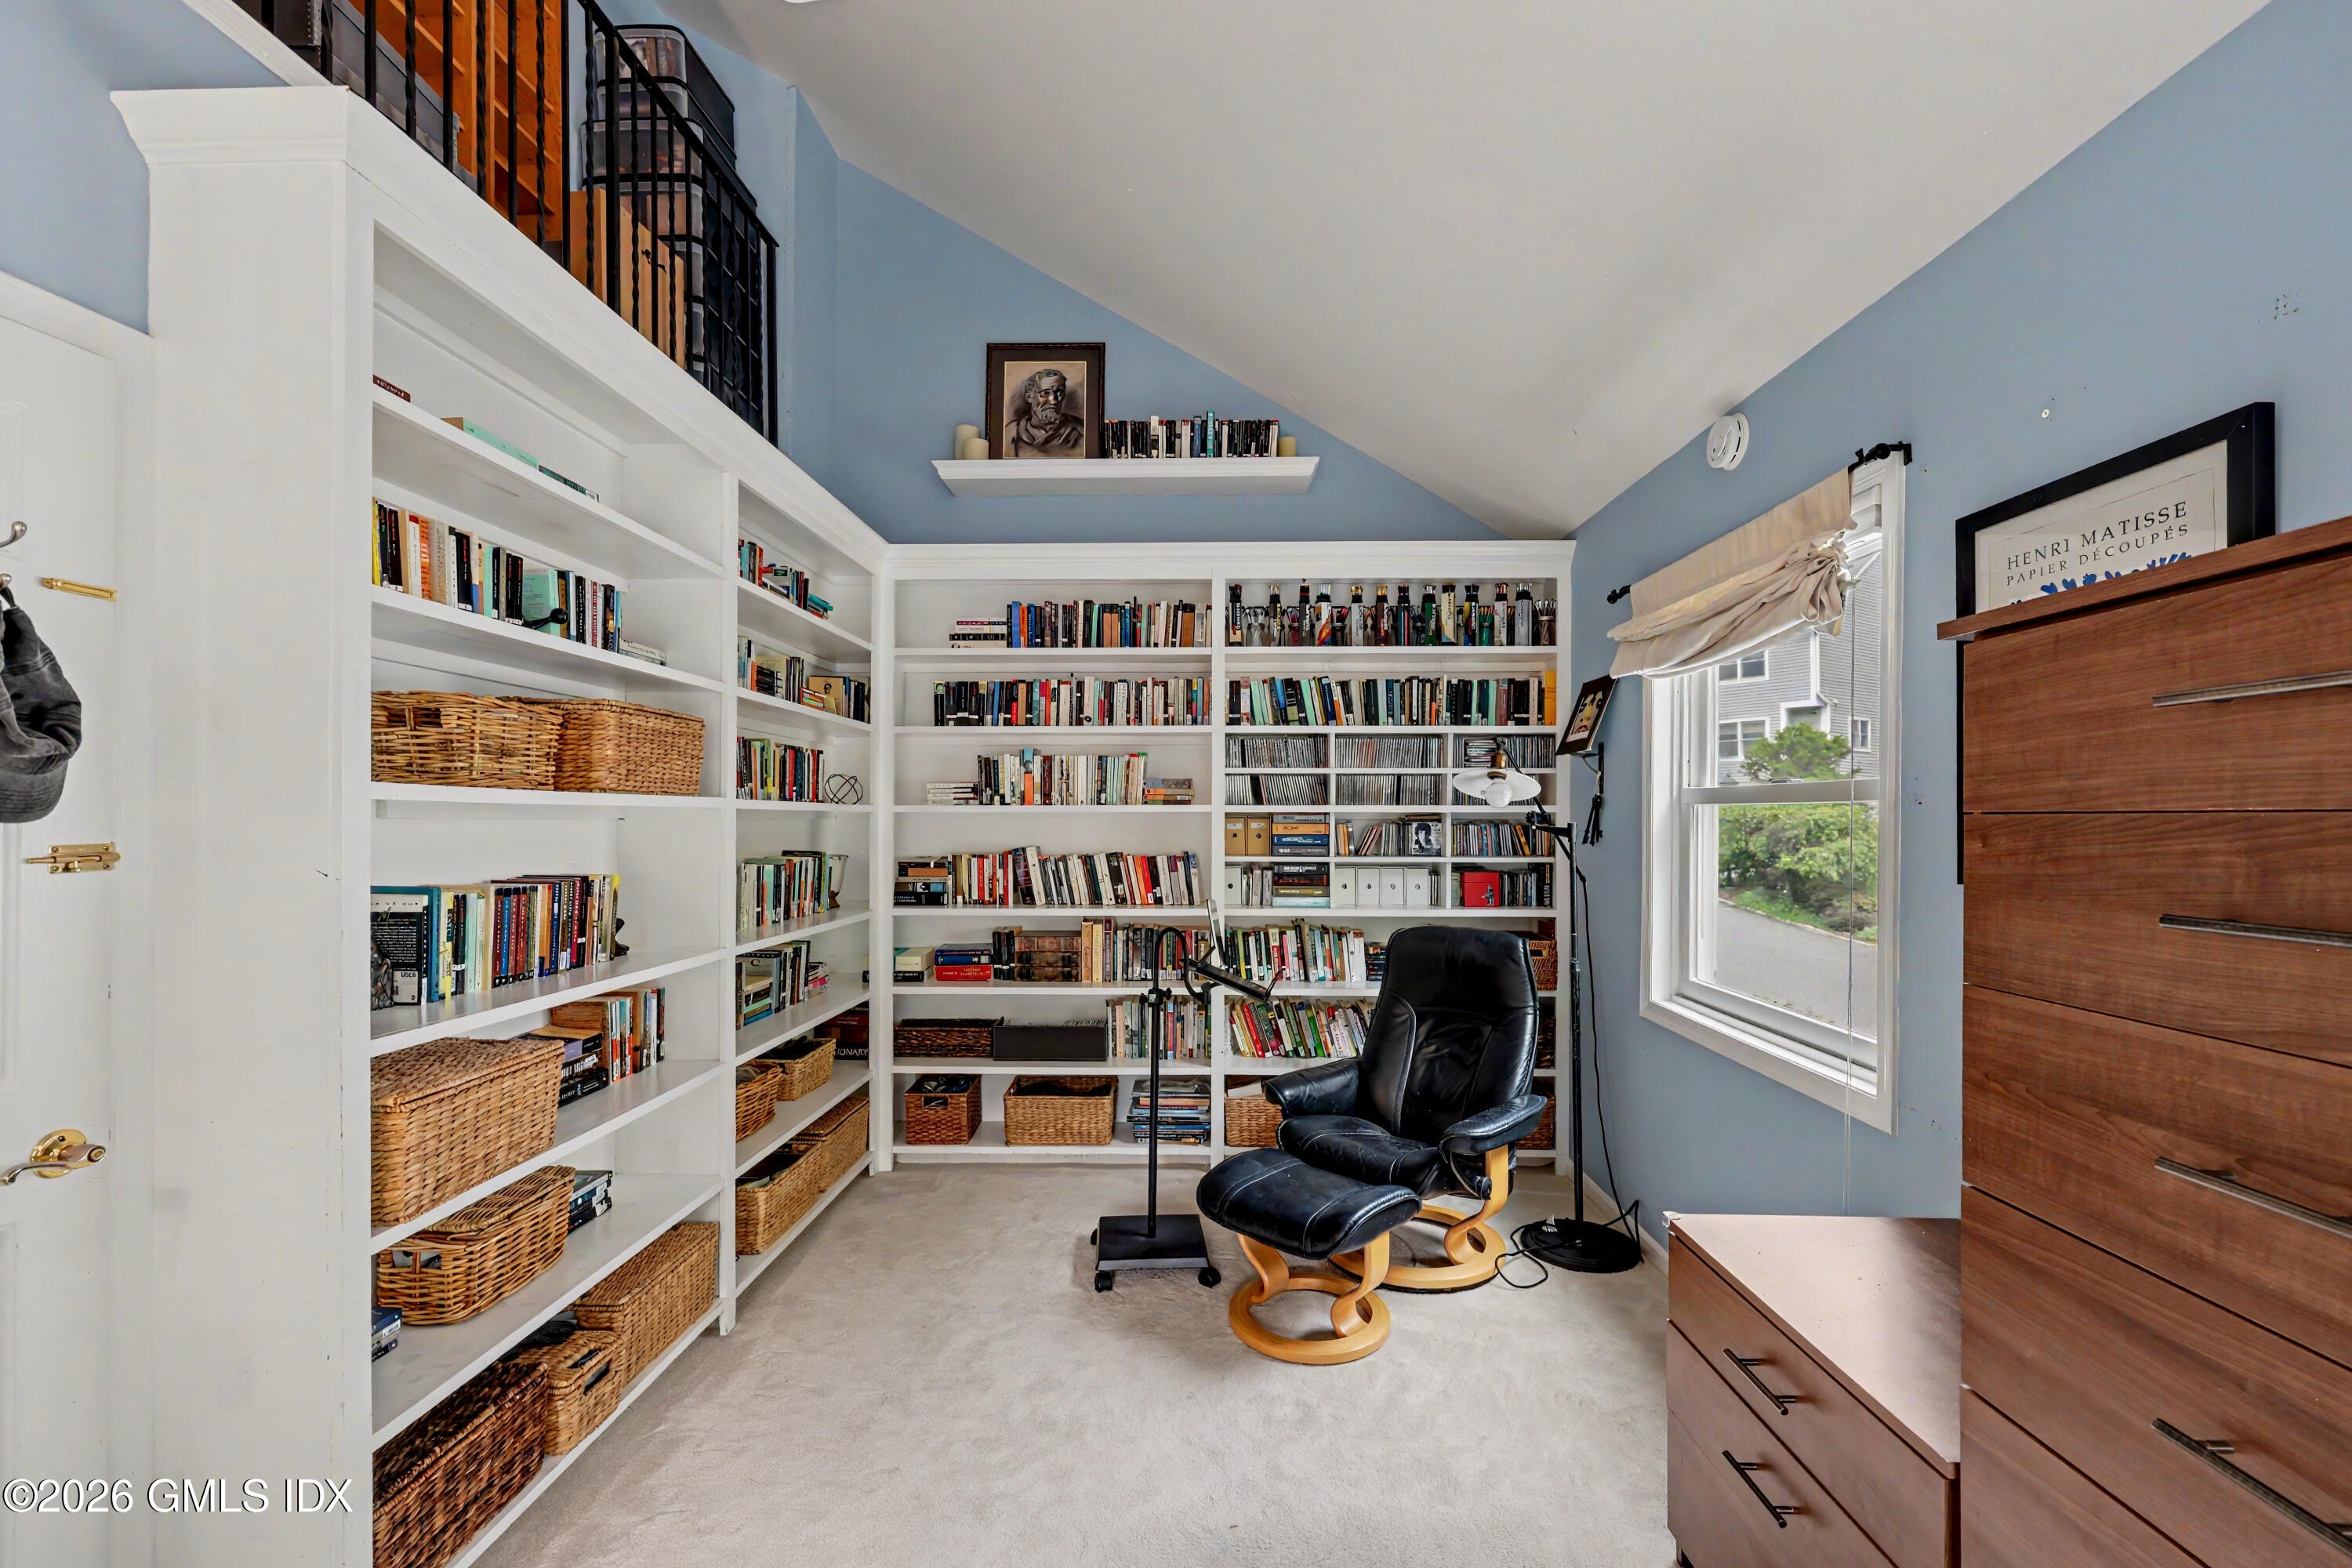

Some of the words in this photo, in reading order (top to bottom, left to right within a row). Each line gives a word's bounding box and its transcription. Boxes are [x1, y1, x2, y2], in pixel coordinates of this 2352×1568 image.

[2006, 539, 2071, 571] HENRI
[2080, 501, 2187, 548] MATISSE
[2006, 560, 2068, 586] PAPIER
[2078, 524, 2188, 566] DÉCOUPÉS
